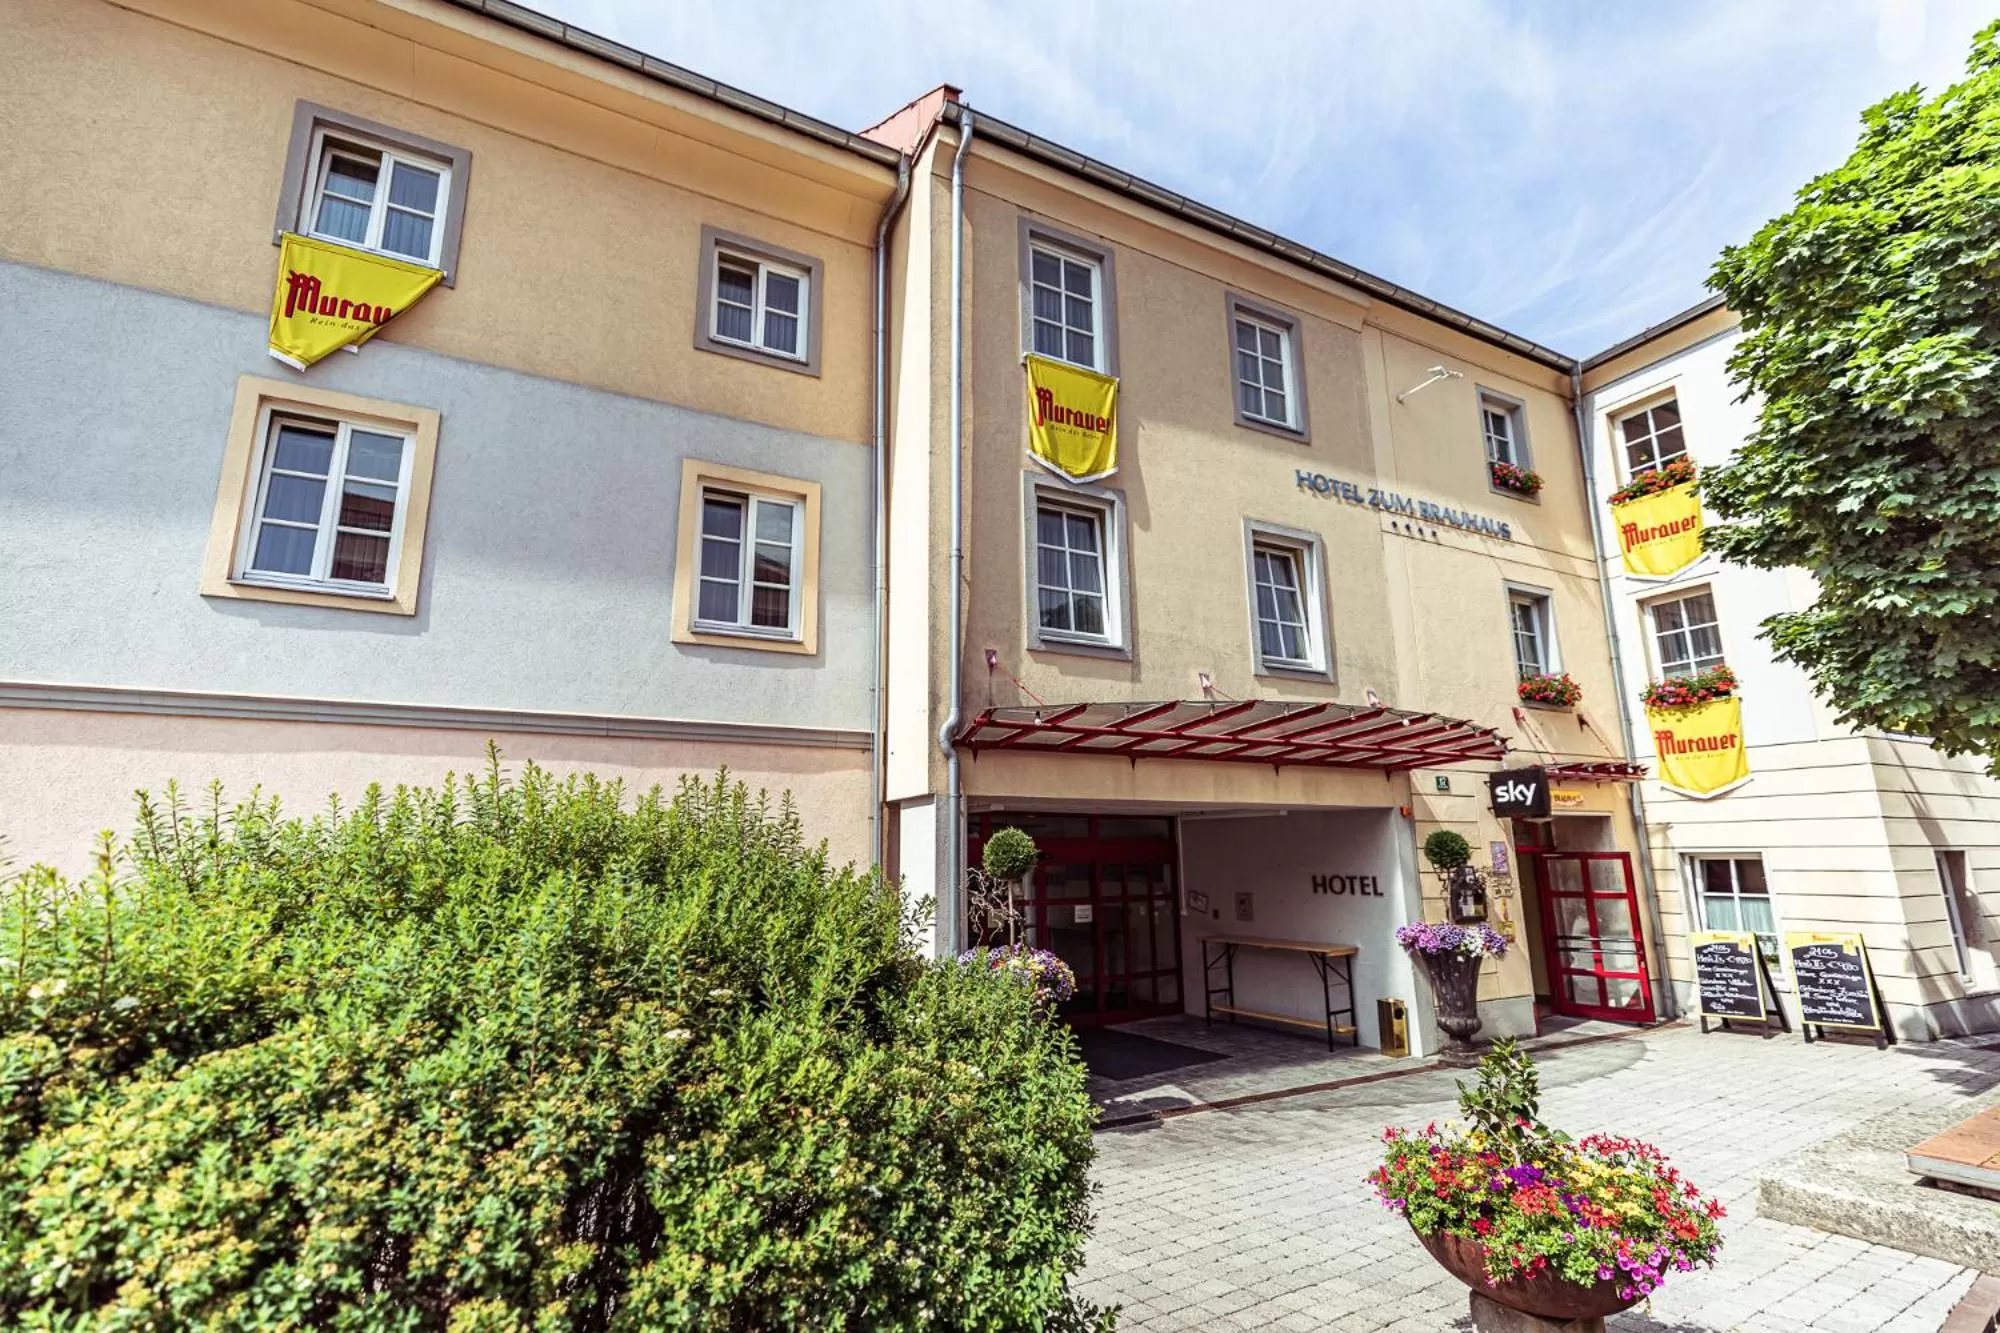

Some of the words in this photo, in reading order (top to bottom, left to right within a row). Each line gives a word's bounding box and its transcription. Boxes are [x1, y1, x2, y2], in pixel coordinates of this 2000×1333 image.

[1036, 386, 1111, 435] Murauer
[1295, 469, 1364, 504] HOTEL
[1368, 488, 1415, 515] ZUM
[1418, 500, 1511, 539] BRAUHAUS
[1622, 515, 1696, 553] Murauer
[1654, 729, 1737, 762] Murauer
[1495, 780, 1536, 806] sky
[1312, 874, 1384, 897] HOTEL
